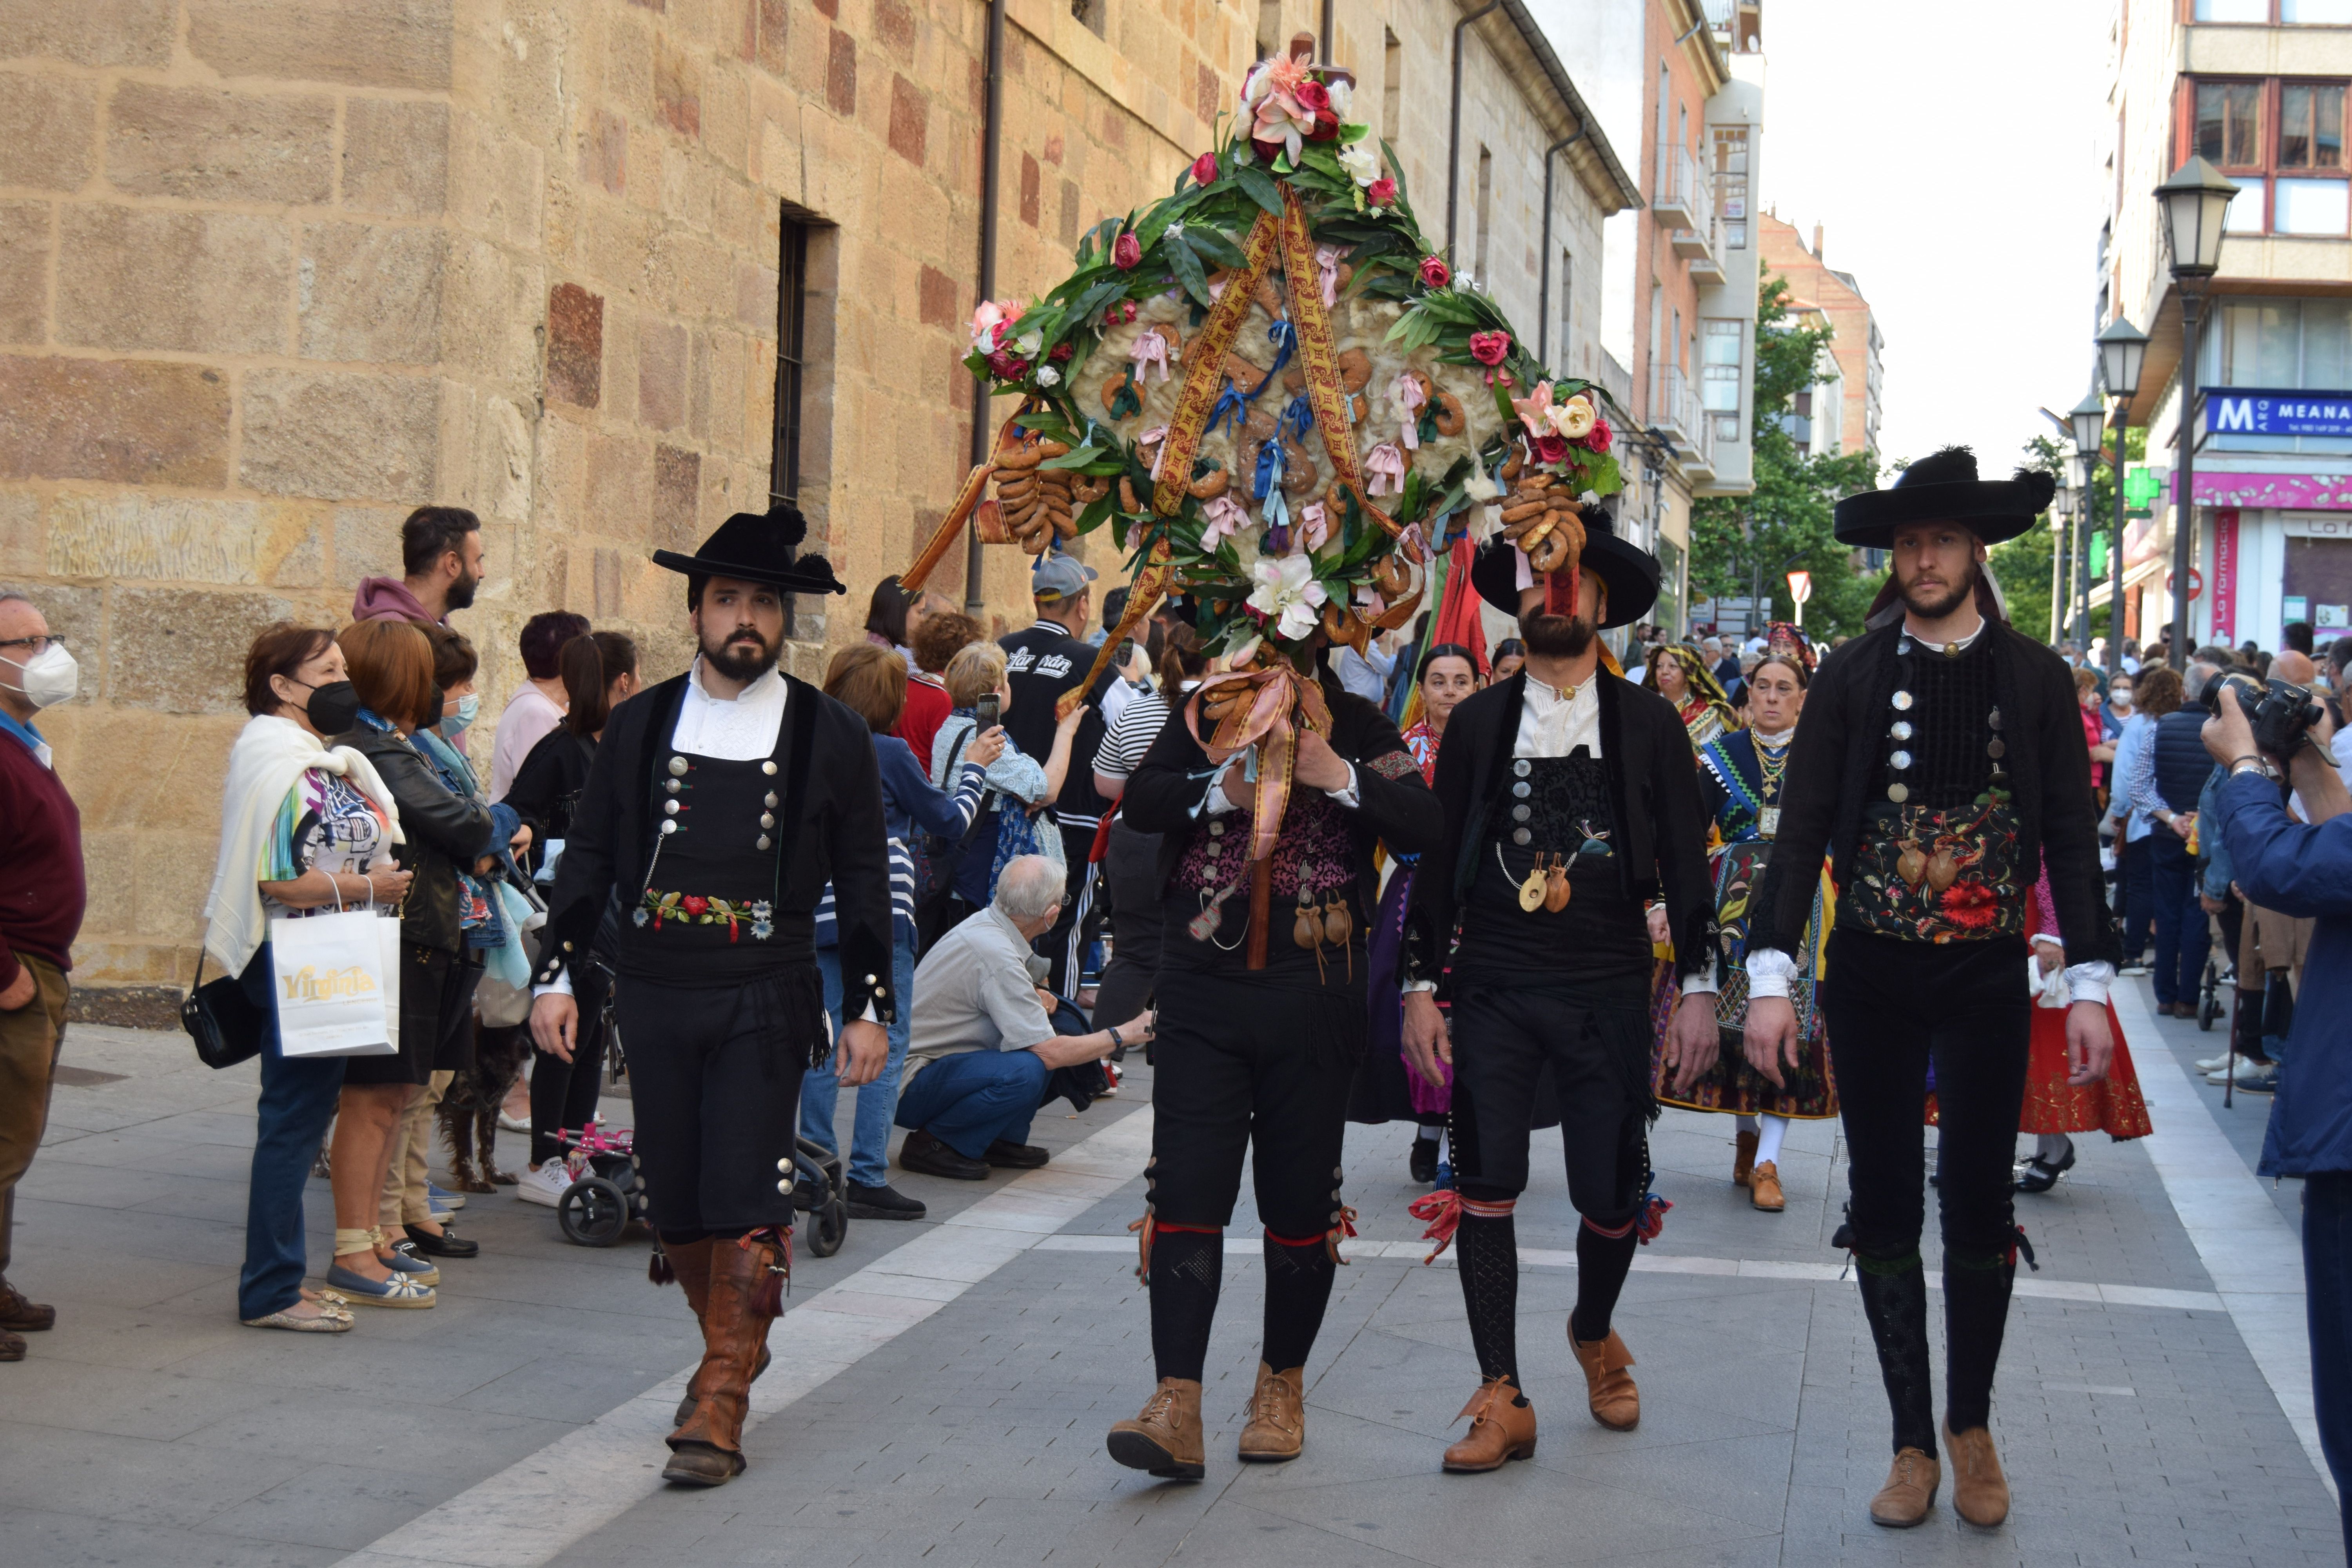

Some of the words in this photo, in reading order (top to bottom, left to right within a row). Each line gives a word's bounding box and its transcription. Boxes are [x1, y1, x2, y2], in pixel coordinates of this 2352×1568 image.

[2217, 398, 2254, 430] M
[2257, 400, 2270, 431] ARQ
[2278, 405, 2350, 419] MEANA
[282, 965, 376, 1003] Virginia
